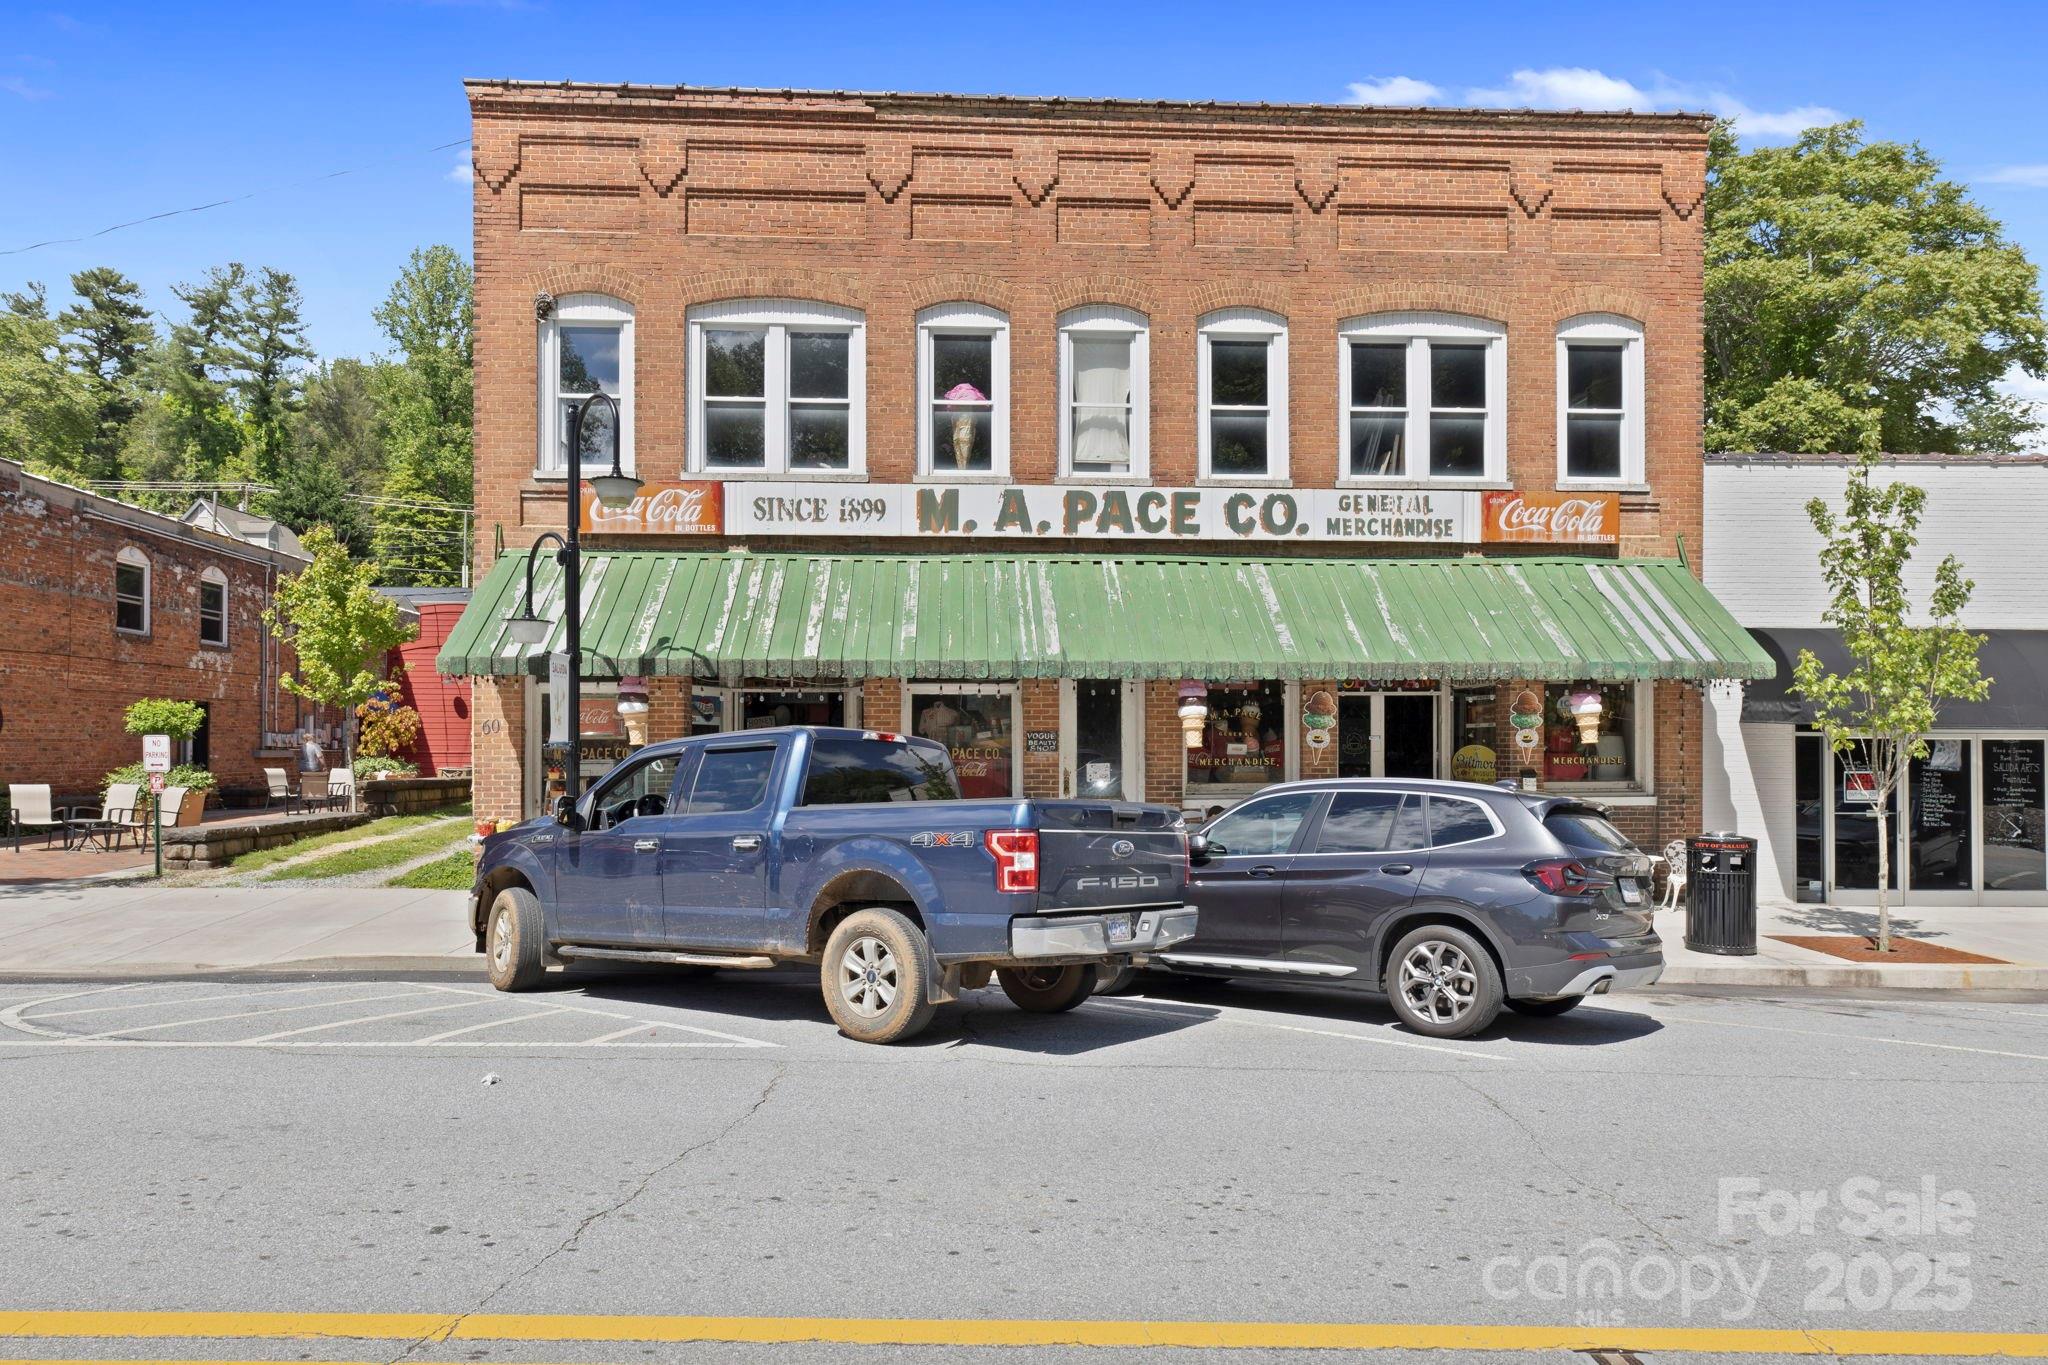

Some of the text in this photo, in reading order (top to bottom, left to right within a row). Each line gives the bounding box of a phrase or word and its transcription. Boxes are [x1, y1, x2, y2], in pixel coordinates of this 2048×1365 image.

[753, 497, 887, 523] SINCE 1899
[1338, 494, 1434, 515] GENERAL
[916, 488, 1310, 537] M. A. PACE CO.
[1499, 498, 1609, 532] Coca-Cola
[674, 524, 716, 532] IN BOTTLES
[1326, 517, 1454, 539] MERCHANDISE
[482, 719, 500, 735] 60
[1026, 732, 1056, 740] VOGUE
[145, 751, 168, 759] PARKING
[581, 747, 611, 760] PACE
[951, 747, 980, 760] PACE
[1993, 763, 2040, 773] SALUDA ARTS
[1077, 875, 1159, 890] F-150
